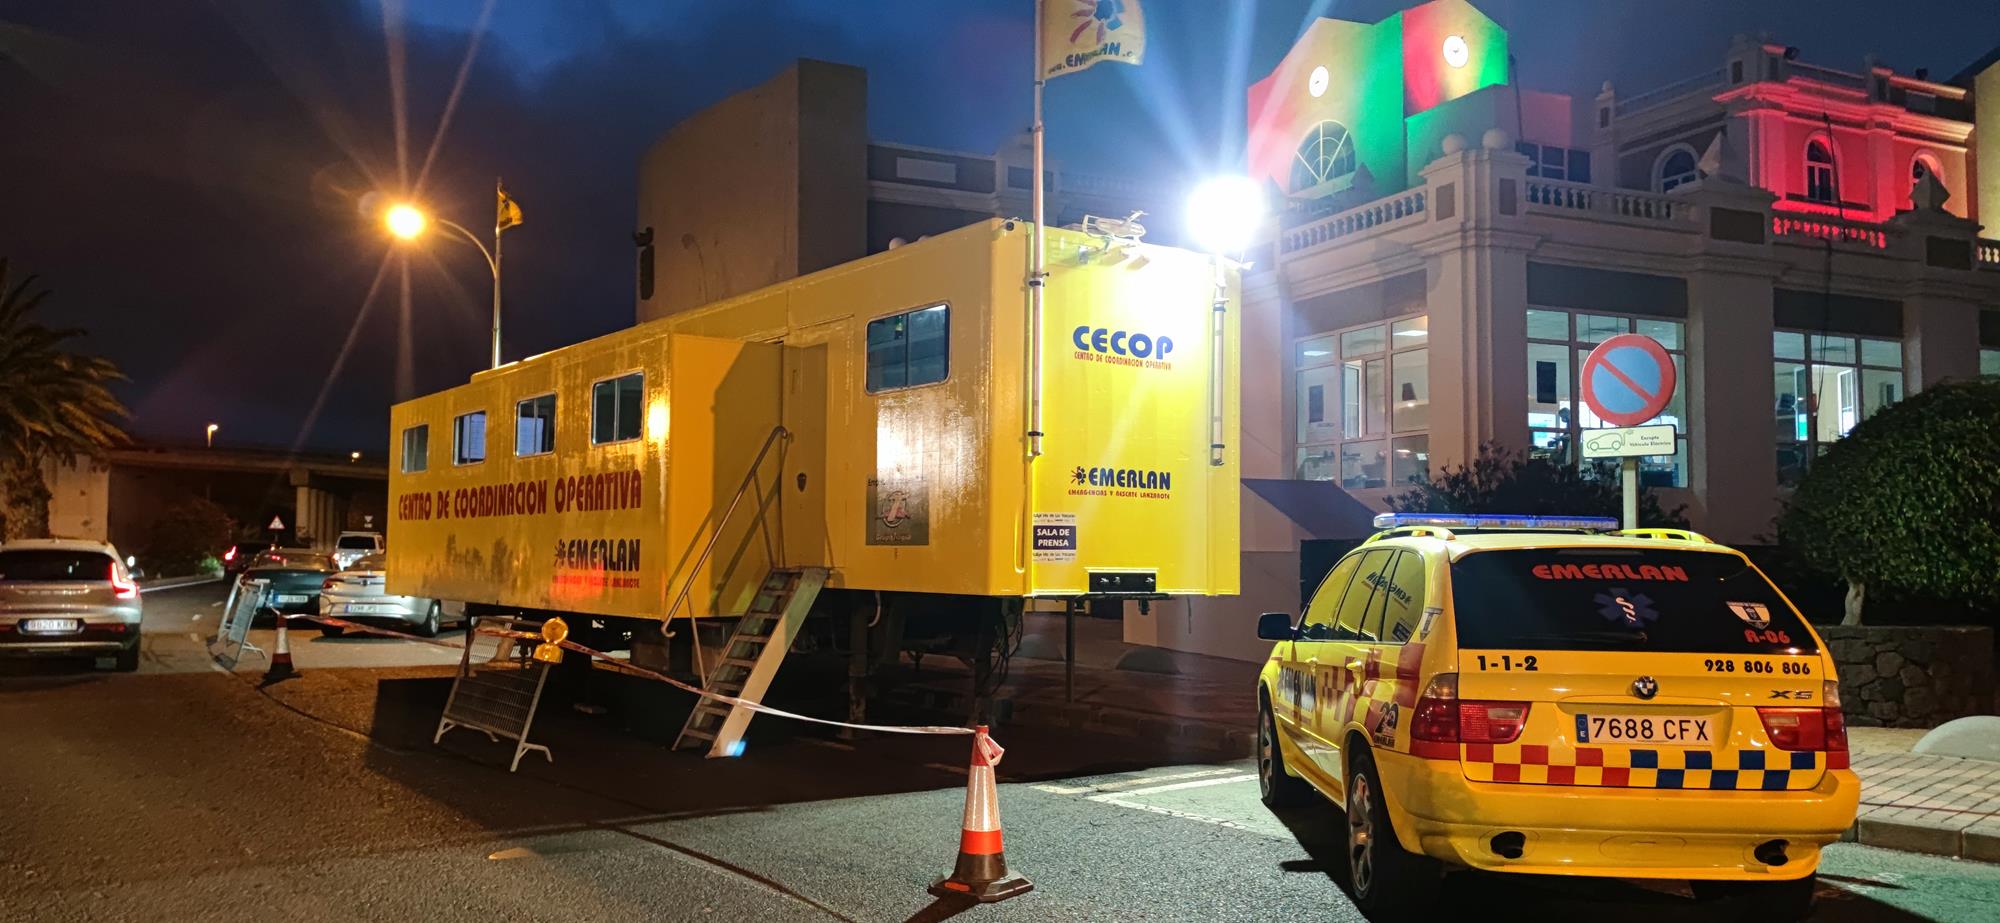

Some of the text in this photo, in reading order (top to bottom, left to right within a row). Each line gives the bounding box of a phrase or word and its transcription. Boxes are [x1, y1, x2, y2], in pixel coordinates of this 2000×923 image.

[1073, 325, 1173, 360] CECOP
[1074, 351, 1094, 361] CENTRO
[1096, 353, 1103, 362] DE
[1088, 467, 1170, 490] EMERLAN
[398, 469, 642, 521] CENTRO DE COORDINACION OPERATIVA
[1036, 528, 1070, 536] SALA DE
[1038, 539, 1069, 547] PRENSA
[567, 538, 640, 572] EMERLAN
[1531, 563, 1689, 582] EMERLAN
[1477, 655, 1539, 671] 1-1-2
[1704, 659, 1811, 675] 928 806 806
[1768, 689, 1813, 700] X5
[1592, 717, 1654, 740] 7688
[1663, 719, 1709, 741] CFX
